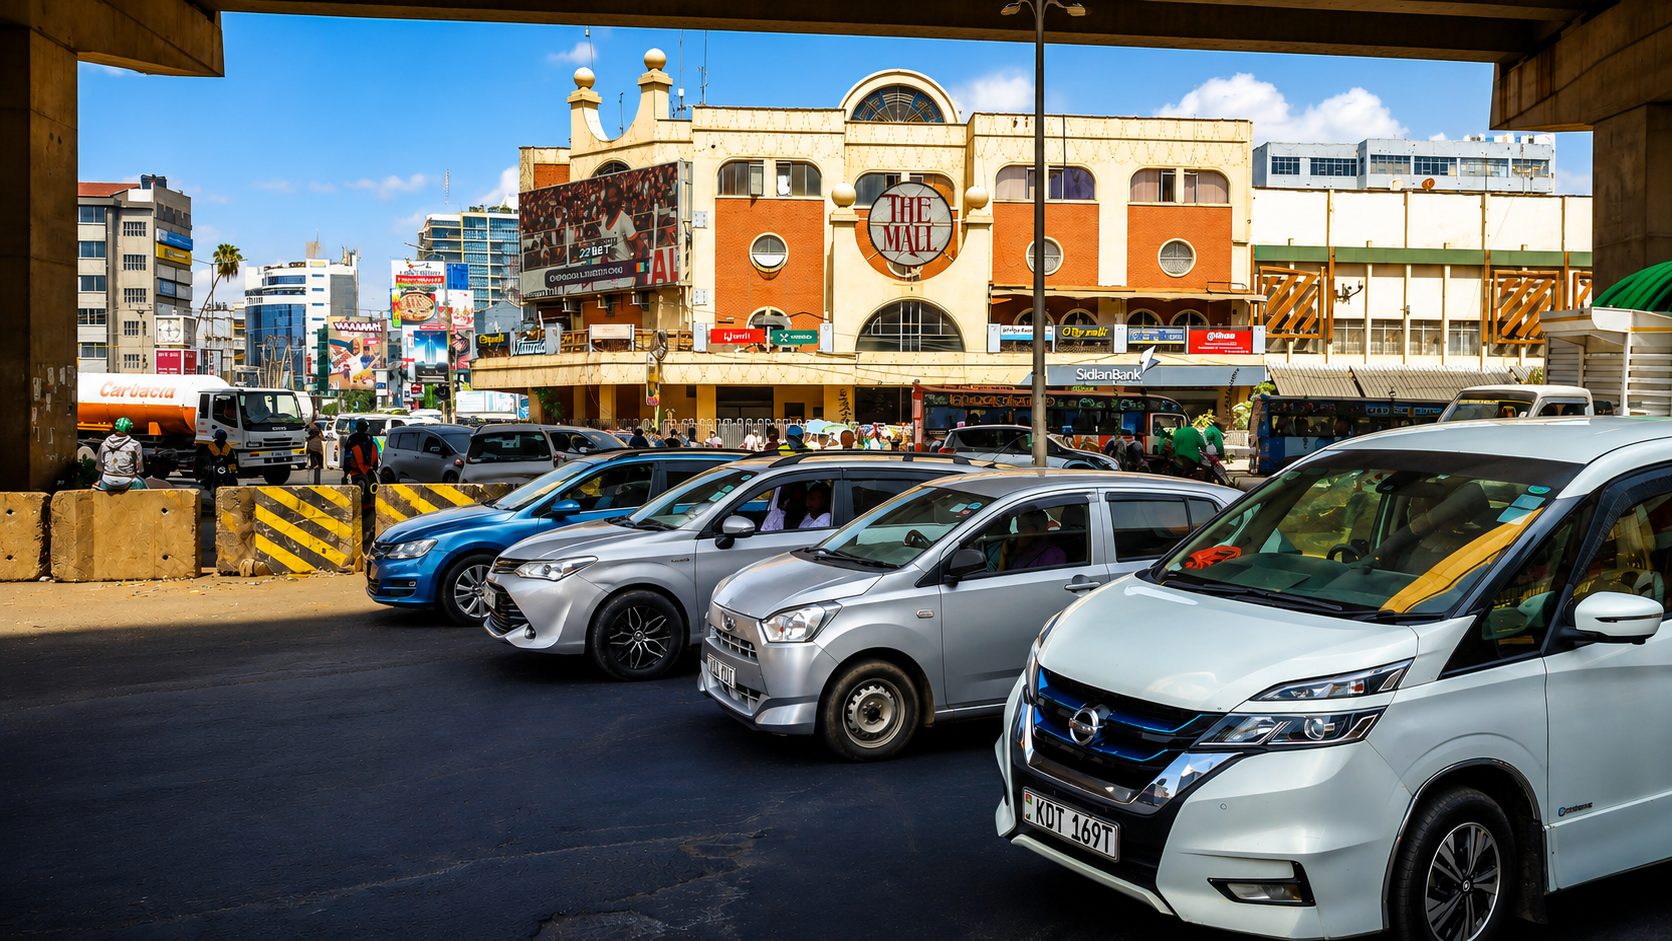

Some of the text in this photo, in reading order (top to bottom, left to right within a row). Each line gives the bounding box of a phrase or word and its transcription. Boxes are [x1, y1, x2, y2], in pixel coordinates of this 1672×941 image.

[880, 194, 931, 223] THE
[881, 226, 939, 258] MALL
[1036, 798, 1113, 853] KDT 169T
